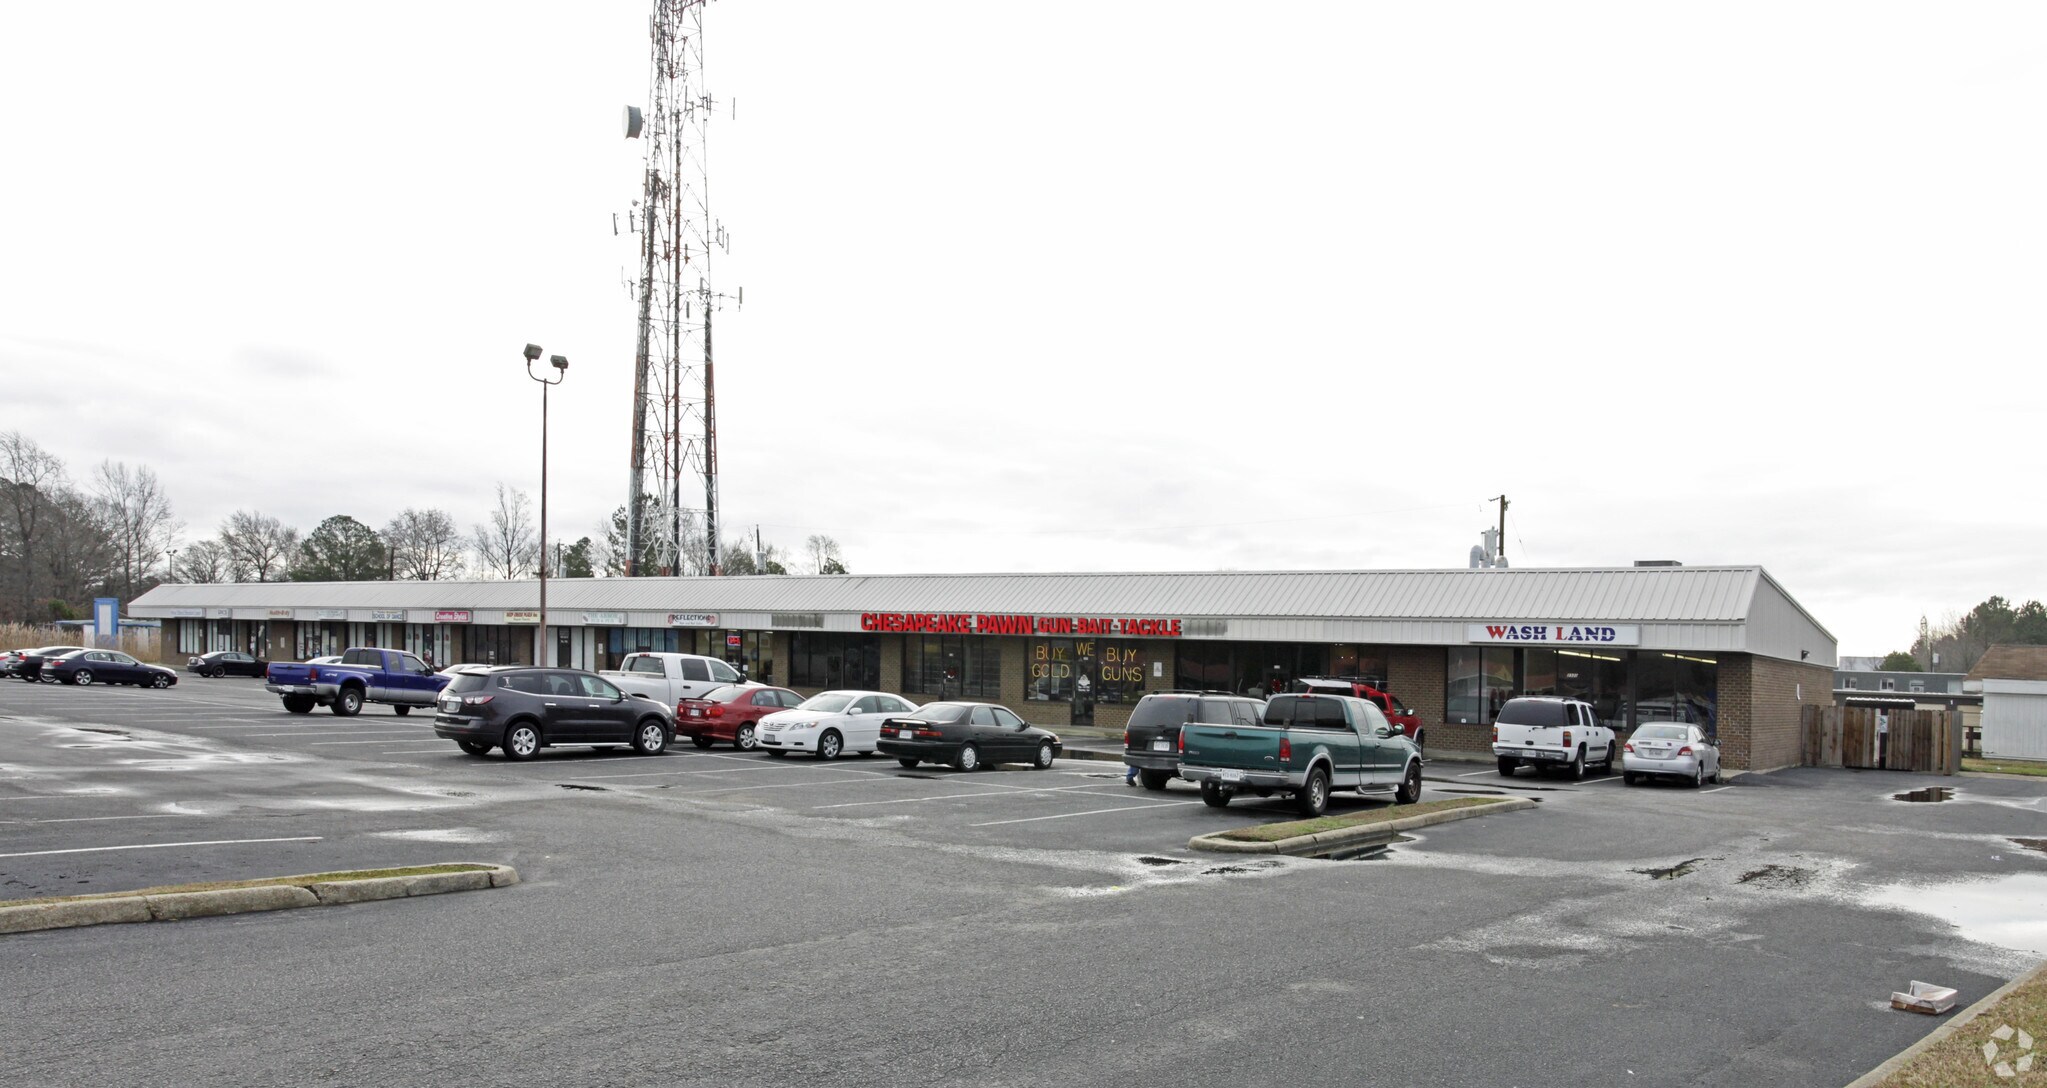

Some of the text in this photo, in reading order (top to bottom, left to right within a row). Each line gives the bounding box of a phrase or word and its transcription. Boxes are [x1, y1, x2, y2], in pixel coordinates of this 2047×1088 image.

[436, 612, 467, 621] Creative Styles
[861, 613, 972, 634] CHESAPEAKE
[976, 614, 1034, 635] PAWN
[1485, 626, 1616, 642] WASH LAND
[1036, 645, 1065, 660] BUY
[1076, 642, 1095, 657] WE
[1106, 647, 1137, 662] BUY
[1031, 663, 1070, 679] GOLD
[1102, 665, 1143, 682] GUNS
